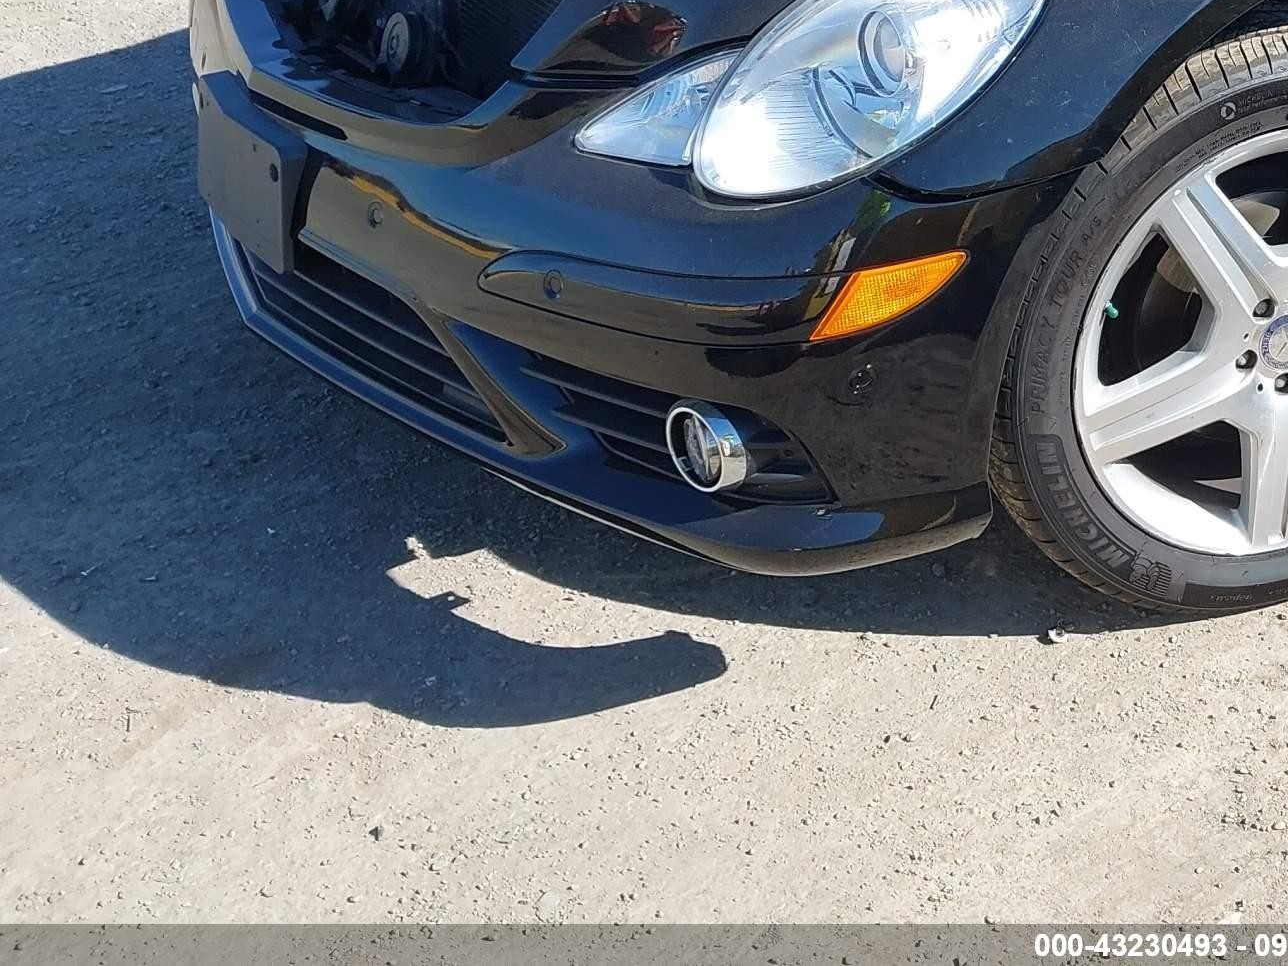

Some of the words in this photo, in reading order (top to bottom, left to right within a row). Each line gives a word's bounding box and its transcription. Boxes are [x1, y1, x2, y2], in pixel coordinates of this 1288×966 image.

[1031, 316, 1056, 414] PRIMACY
[1050, 249, 1083, 310] TOUR
[1035, 442, 1130, 569] MICHELIN
